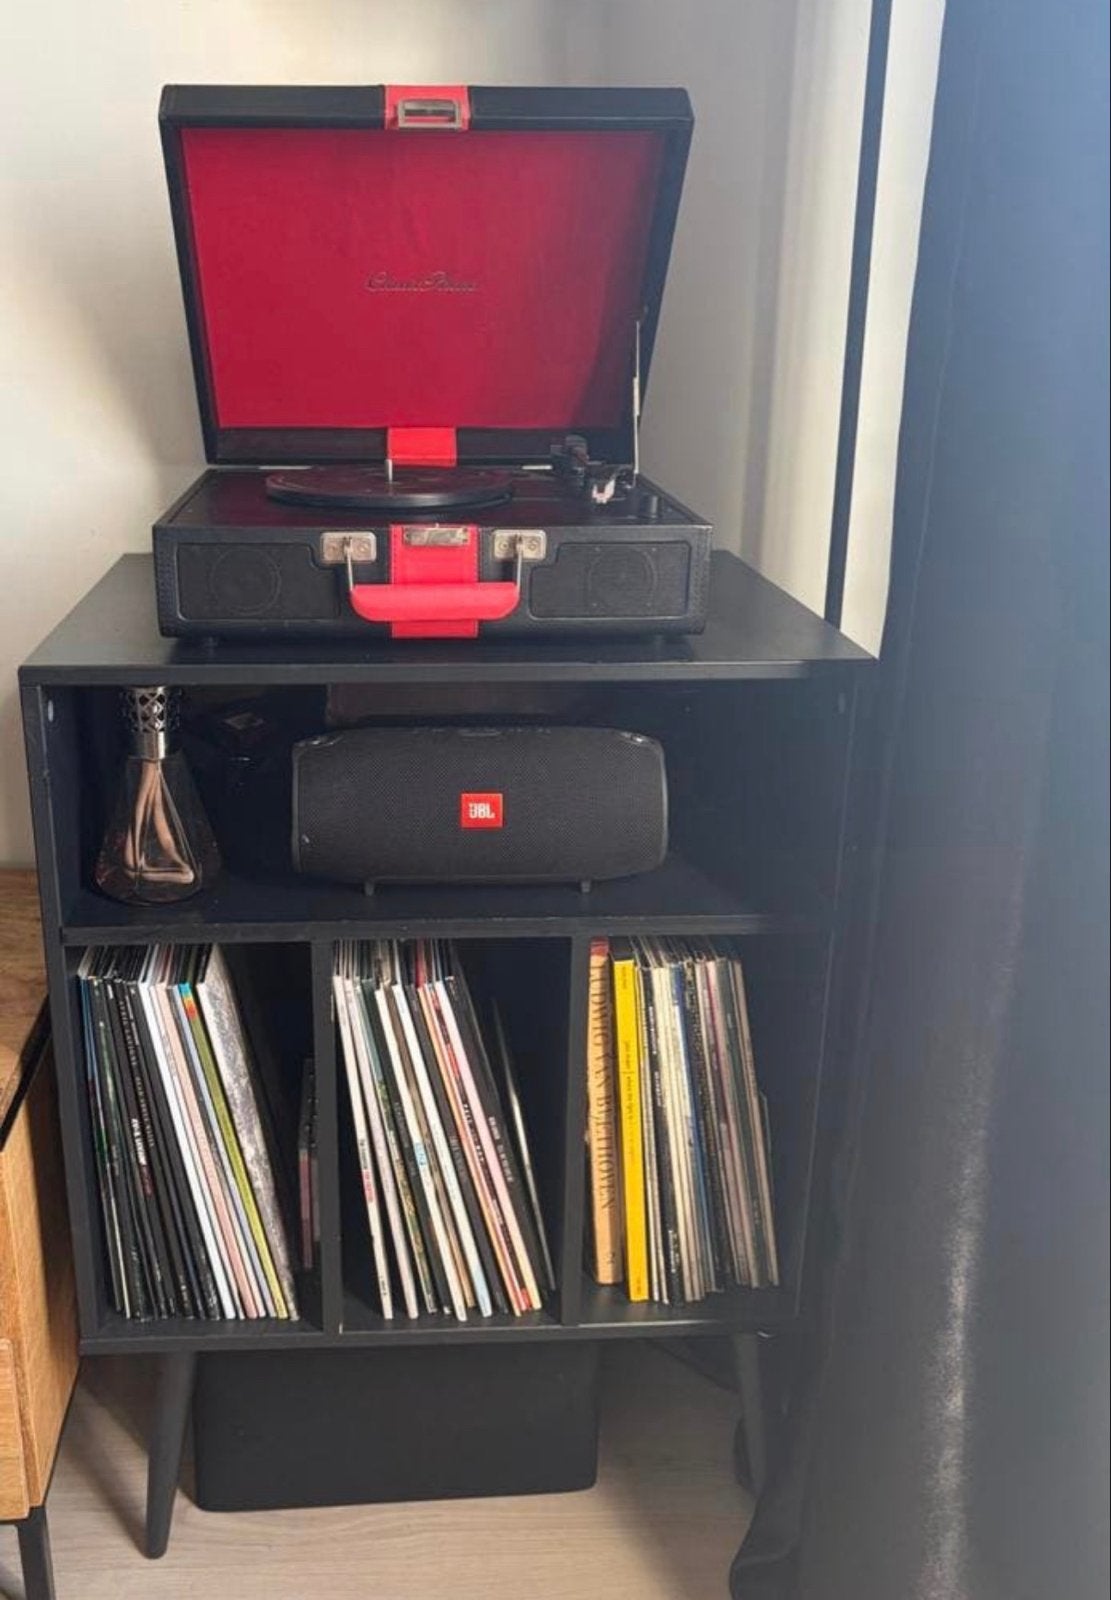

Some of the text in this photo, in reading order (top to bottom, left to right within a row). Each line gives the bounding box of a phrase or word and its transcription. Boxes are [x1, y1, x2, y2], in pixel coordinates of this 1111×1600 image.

[469, 803, 496, 819] JBL
[590, 963, 618, 1210] LUDWIG VAN BEETHOVEN
